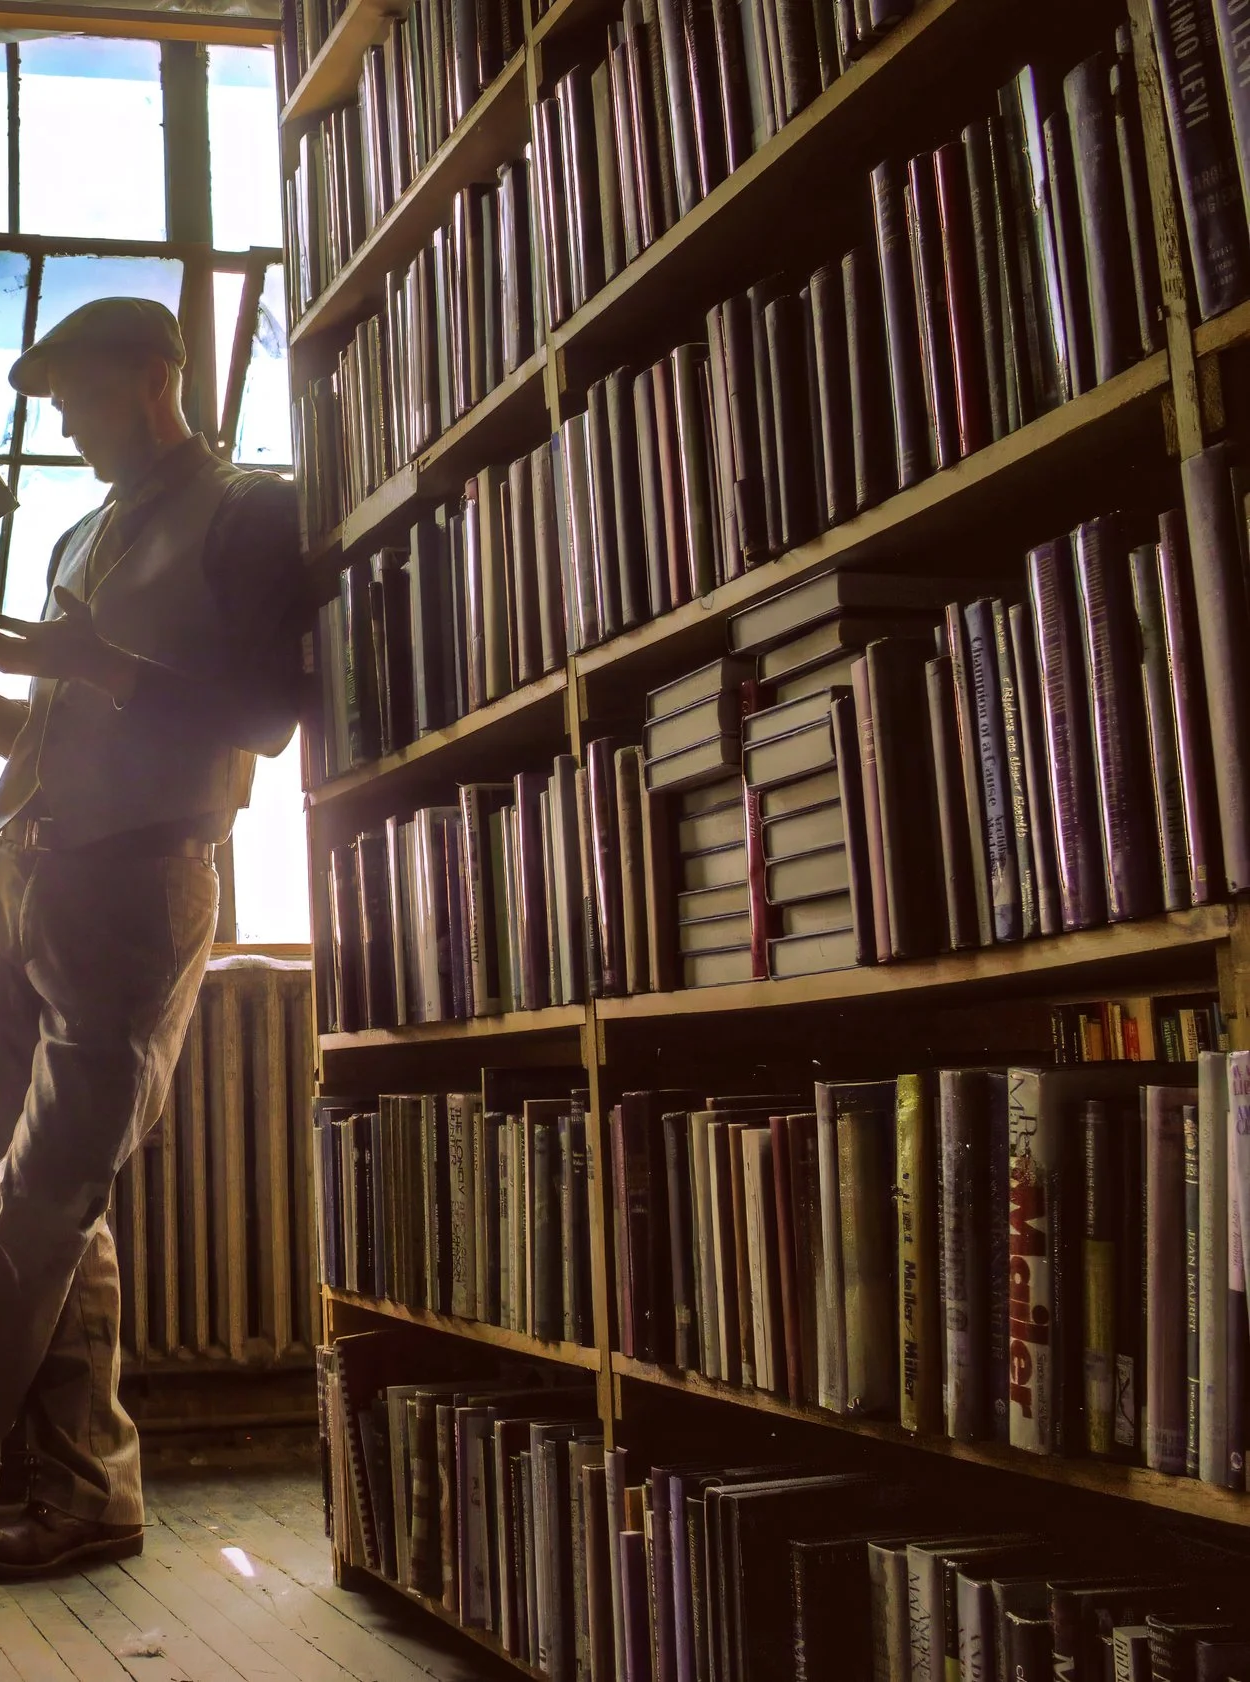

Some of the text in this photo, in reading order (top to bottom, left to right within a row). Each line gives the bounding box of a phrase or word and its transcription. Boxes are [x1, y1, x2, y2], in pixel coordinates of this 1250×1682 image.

[1177, 61, 1211, 129] LEVI
[969, 635, 998, 808] Champion of a Cause
[454, 1107, 464, 1195] THE LONELY
[1187, 1229, 1196, 1267] JEAN
[1009, 1184, 1049, 1419] Mailer
